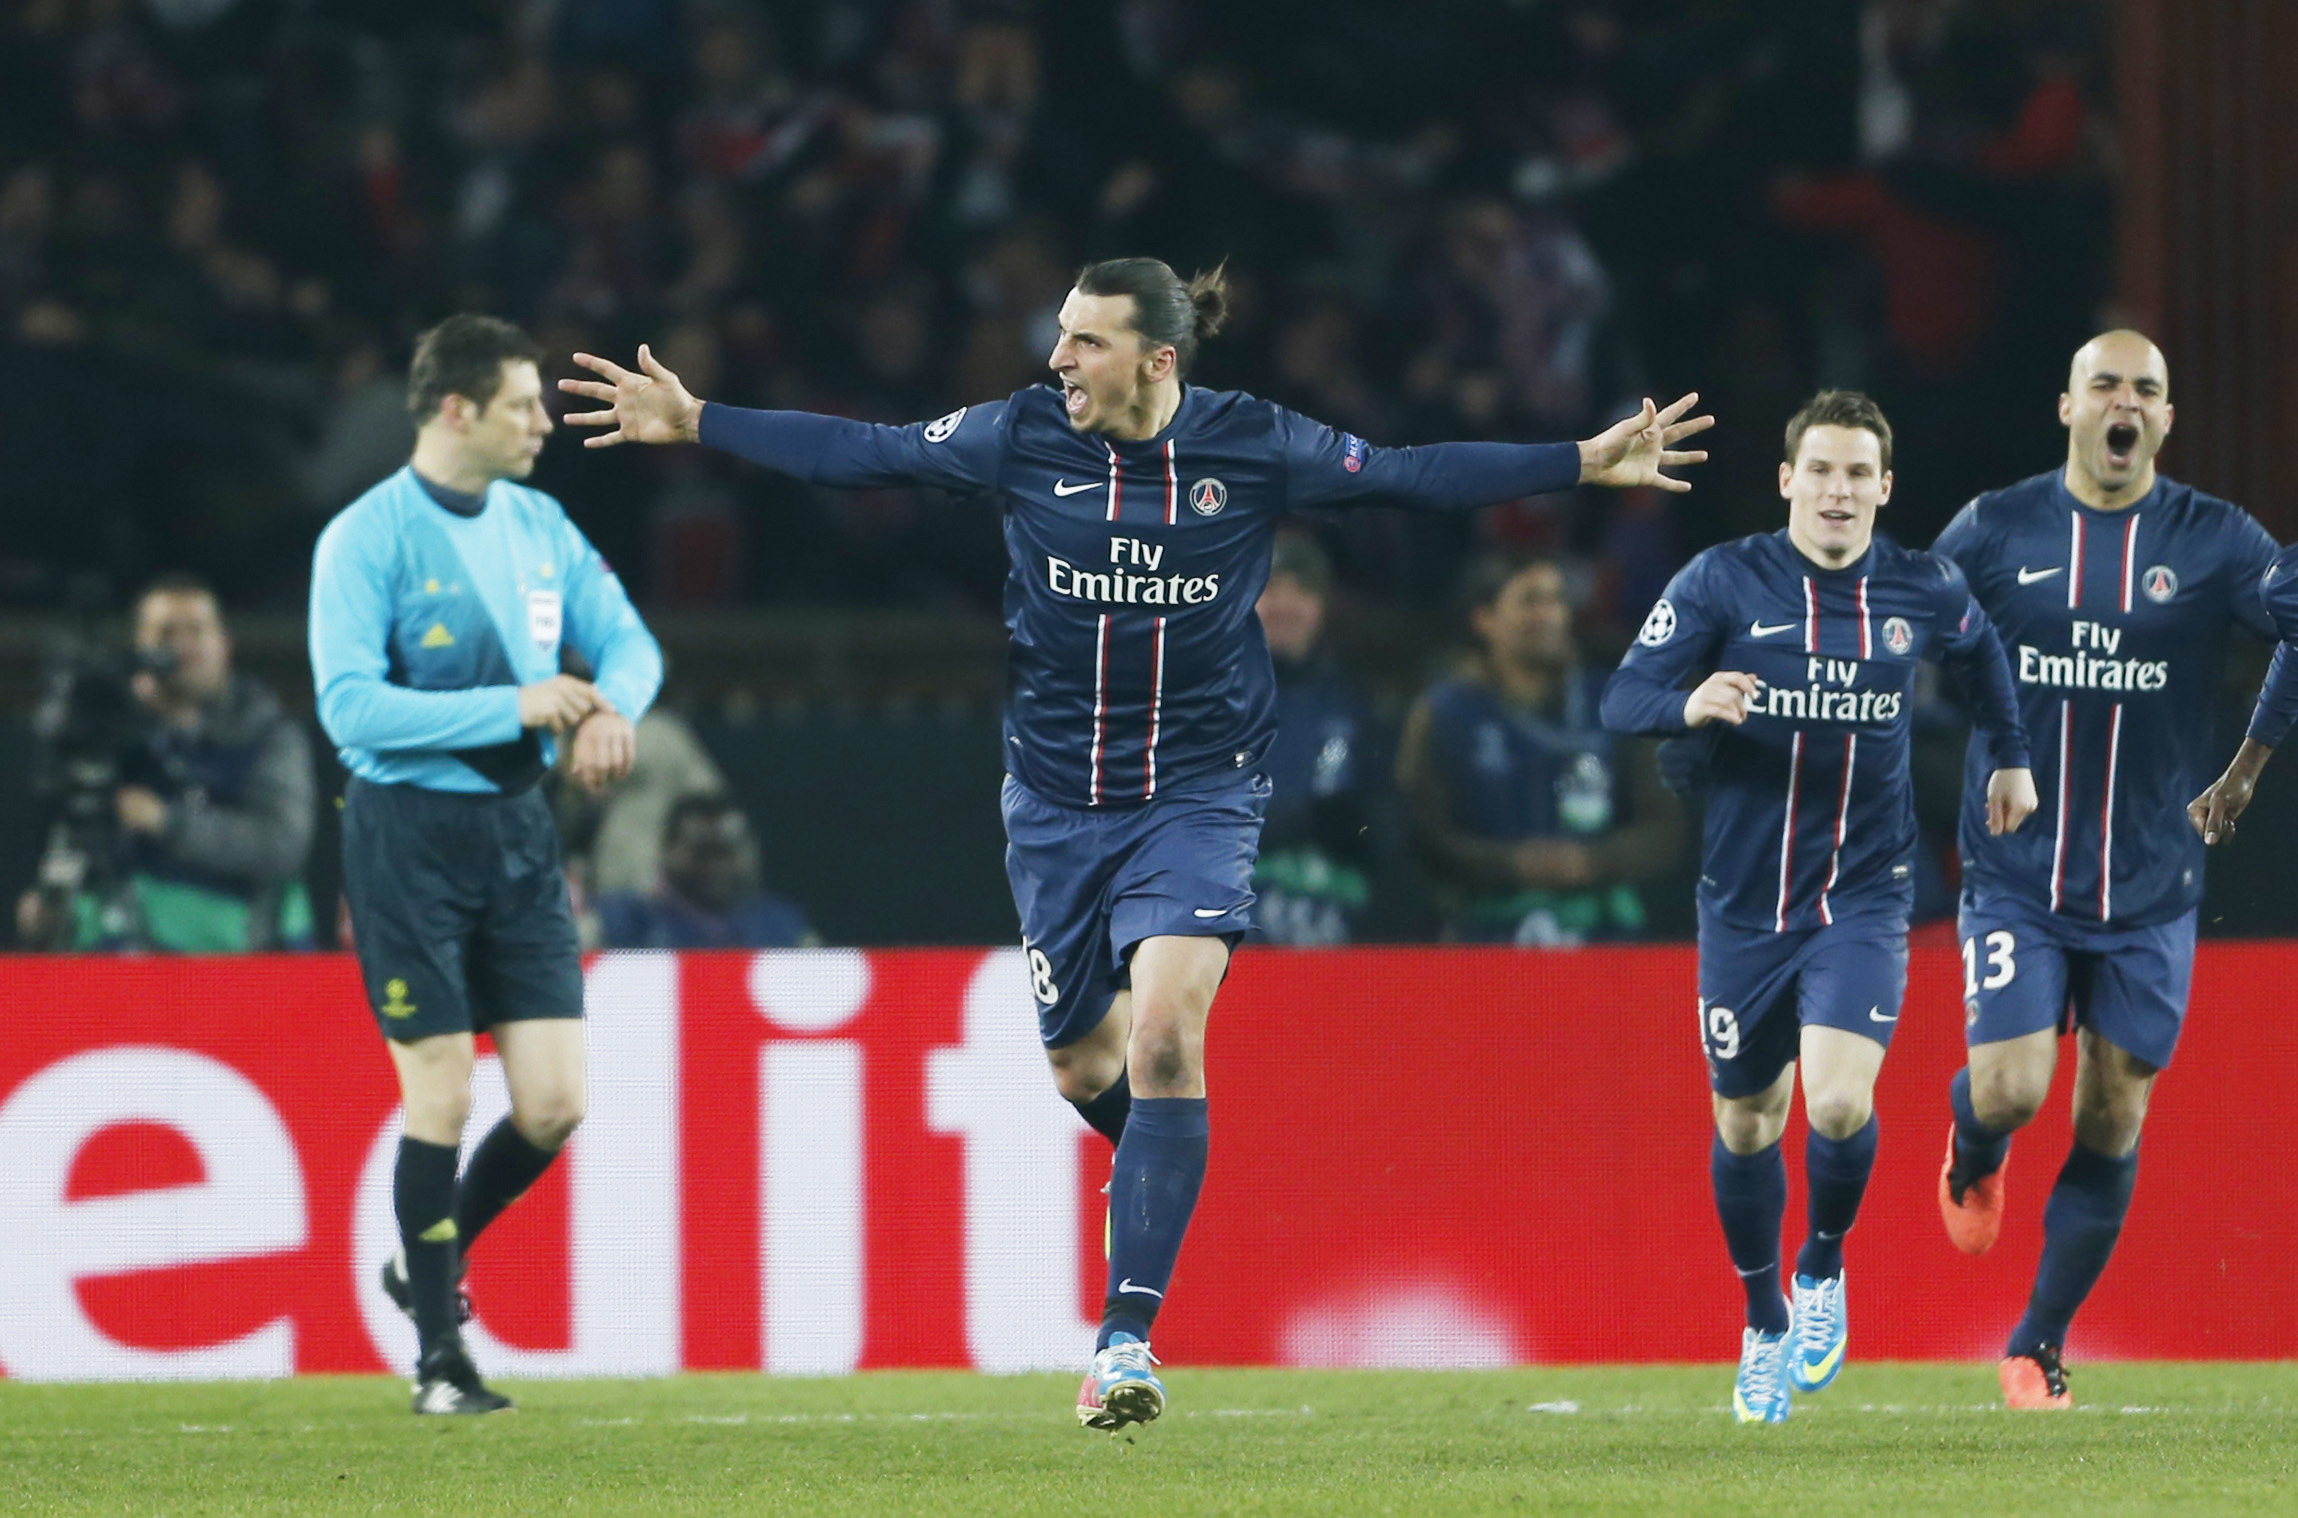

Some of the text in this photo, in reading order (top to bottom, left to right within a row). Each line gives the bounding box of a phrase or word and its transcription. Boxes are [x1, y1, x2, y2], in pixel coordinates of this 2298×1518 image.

[1110, 536, 1164, 571] Fly
[1047, 555, 1220, 605] Emirates
[2071, 620, 2121, 656] Fly
[1807, 656, 1858, 688] Fly
[2018, 645, 2168, 691] Emirates
[1962, 930, 2016, 999] 13
